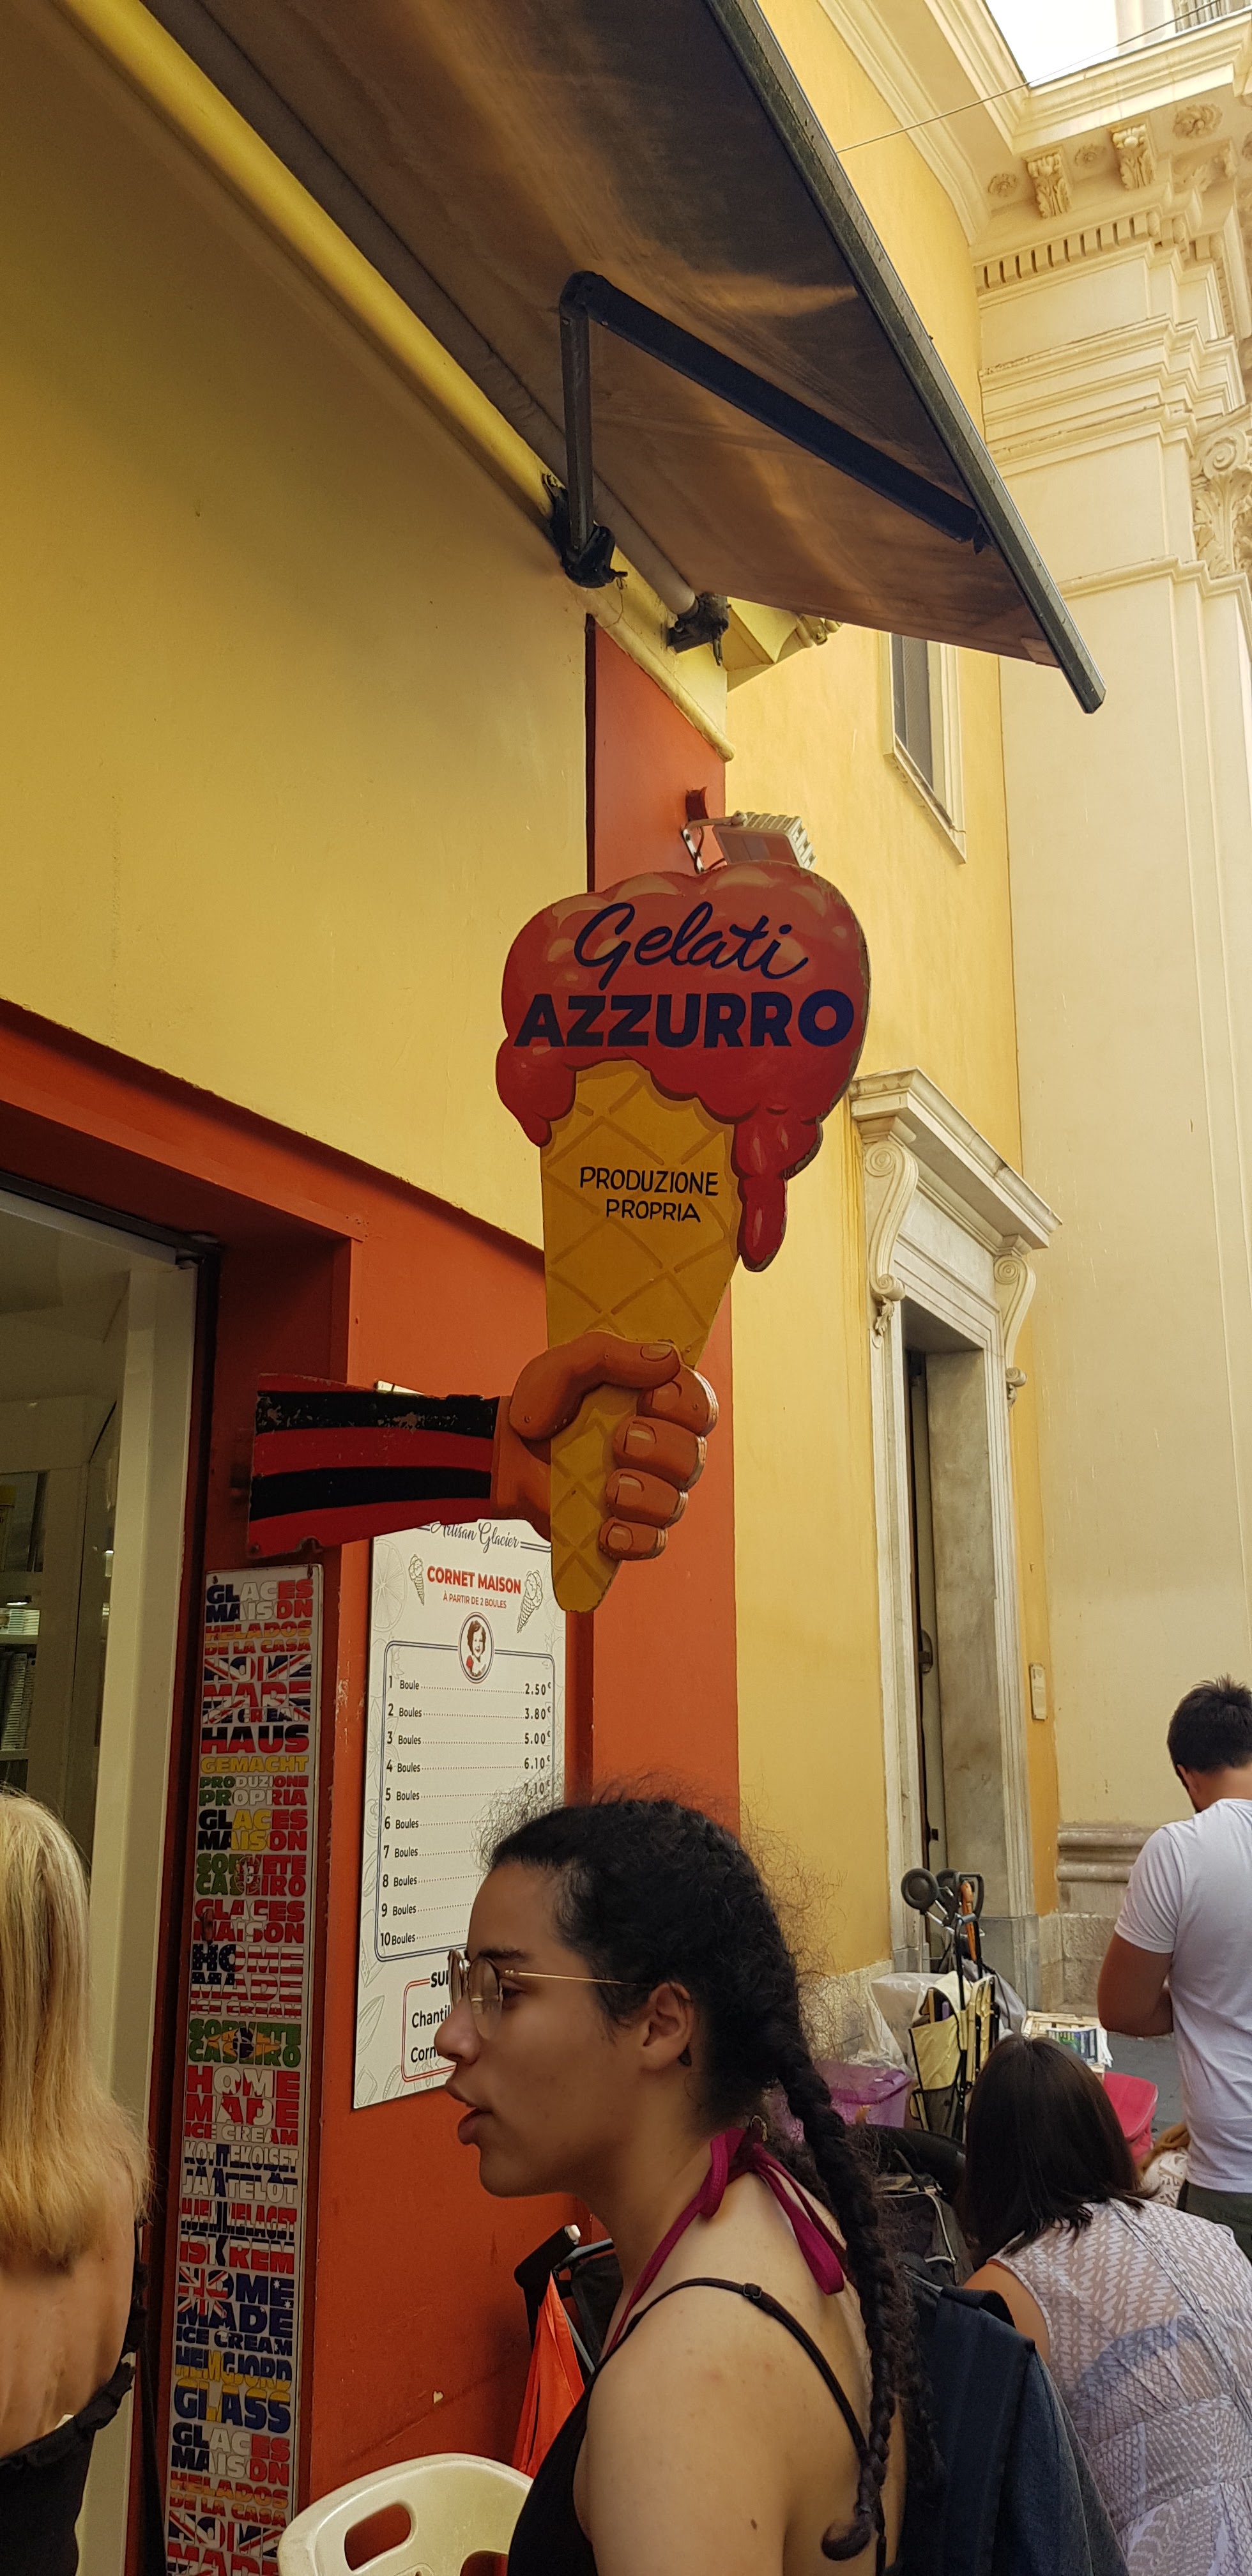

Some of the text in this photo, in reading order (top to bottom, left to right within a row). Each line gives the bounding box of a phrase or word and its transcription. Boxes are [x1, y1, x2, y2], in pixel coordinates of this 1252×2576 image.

[574, 901, 808, 990] Gelati
[513, 988, 854, 1048] AZZURRO
[579, 1167, 719, 1196] PRODUZIONE
[606, 1199, 701, 1223] PROPRIA
[478, 1522, 520, 1554] Glacier
[206, 1579, 313, 1604] GLACES
[427, 1565, 521, 1594] CORNET MAISON
[206, 1600, 313, 1623] MAISON
[443, 1590, 448, 1601] À
[449, 1593, 470, 1604] PARTIR
[471, 1597, 479, 1605] DE
[485, 1599, 507, 1609] BOULES
[205, 1620, 312, 1642] HELADOS
[205, 1638, 311, 1656] DE LA CASA
[204, 1654, 312, 1683] HOME
[203, 1681, 311, 1708] MADE
[389, 1676, 393, 1688] 1
[400, 1680, 419, 1690] Boule
[202, 1706, 310, 1724] ICE CREAM
[388, 1703, 394, 1716] 2
[399, 1707, 422, 1717] Boules
[201, 1724, 310, 1754] HAUS
[387, 1731, 393, 1744] 3
[398, 1735, 421, 1745] Boules
[201, 1756, 309, 1774] GEMACHT
[386, 1759, 393, 1772] 4
[397, 1762, 420, 1773] Boules
[199, 1775, 309, 1789] PRODUZIONE
[199, 1789, 307, 1807] PROPRIA
[385, 1788, 391, 1801] 5
[396, 1791, 420, 1800] Boules
[199, 1809, 308, 1830] GLACES
[385, 1816, 419, 1829] 6 Boules
[197, 1830, 307, 1851] MAISON
[383, 1845, 418, 1859] 7 Boules
[197, 1853, 307, 1875] SORVETE
[196, 1873, 306, 1897] CASEIRO
[383, 1874, 417, 1887] 8 Boules
[195, 1898, 305, 1922] GLACES
[381, 1903, 416, 1917] 9 Boules
[381, 1932, 415, 1946] 10 Boules
[191, 1943, 303, 1974] HOME
[191, 1972, 303, 2003] MADE
[190, 1999, 302, 2019] ICE CREAM
[412, 2004, 450, 2028] Chantil
[189, 2018, 302, 2046] SORVETE
[188, 2038, 301, 2067] CASEIRO
[411, 2046, 436, 2062] Corn
[187, 2065, 300, 2099] HOME
[185, 2094, 299, 2128] MADE
[185, 2122, 298, 2146] ICE CREAM
[179, 2230, 294, 2274] ISKREM
[178, 2266, 294, 2308] HOME
[177, 2296, 293, 2339] MADE
[176, 2325, 293, 2357] ICE CREAM
[174, 2377, 291, 2434] GLASS
[172, 2422, 290, 2462] GLACES
[171, 2445, 289, 2486] MAISON
[171, 2471, 288, 2509] HELADOS
[169, 2492, 287, 2527] DE LA CASA
[168, 2510, 284, 2559] HOME
